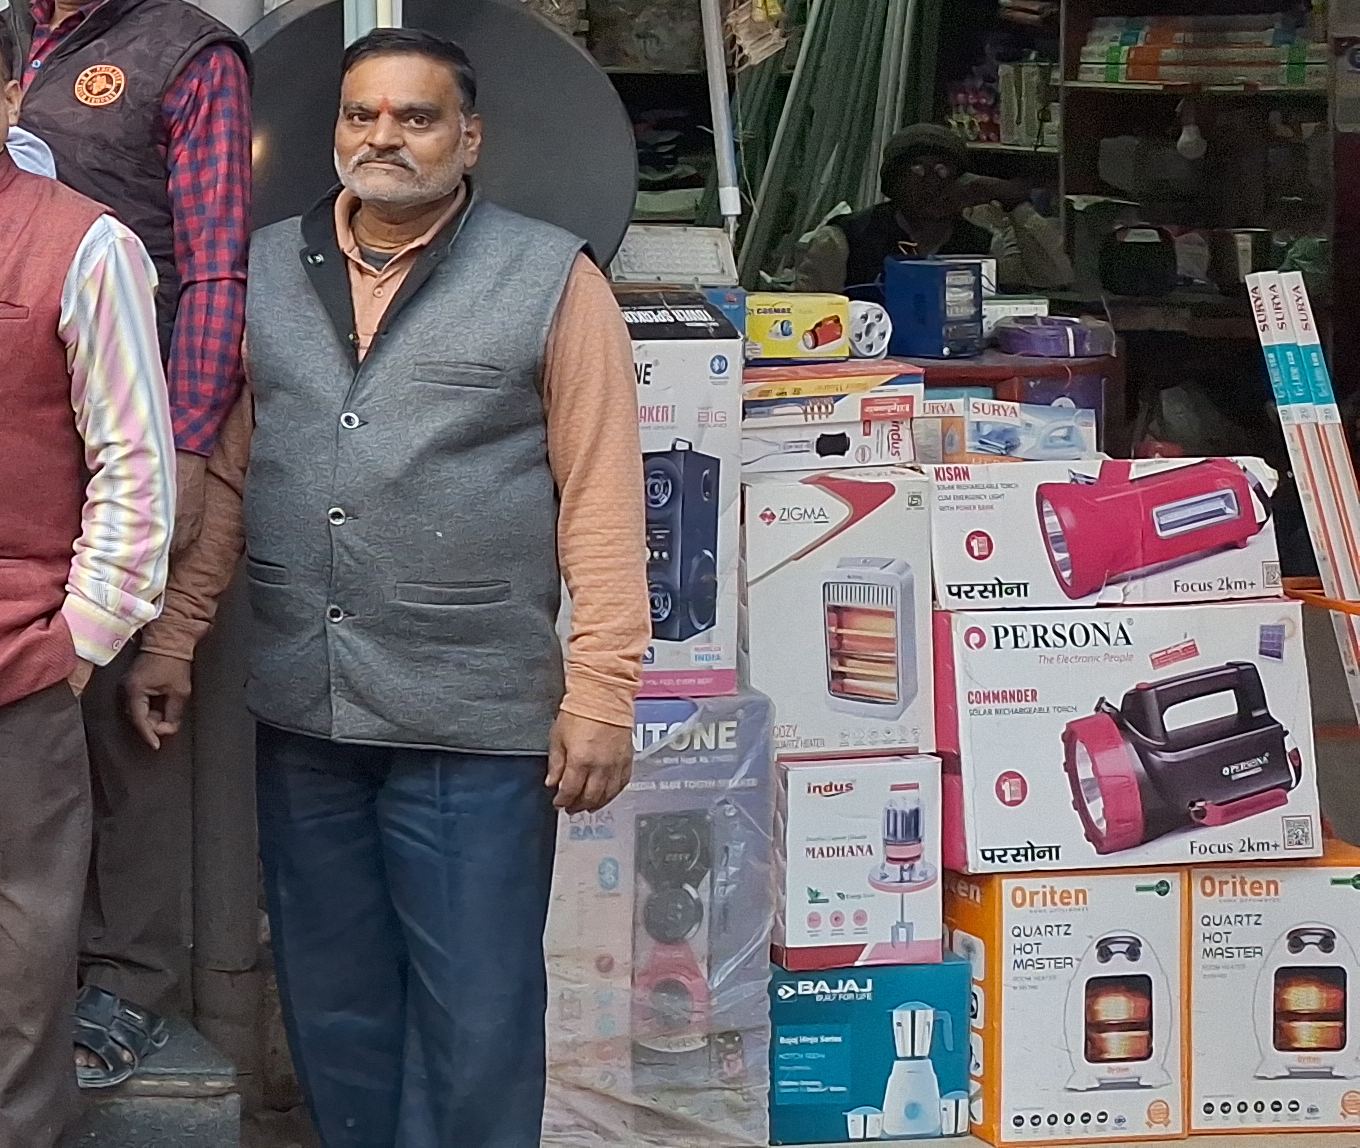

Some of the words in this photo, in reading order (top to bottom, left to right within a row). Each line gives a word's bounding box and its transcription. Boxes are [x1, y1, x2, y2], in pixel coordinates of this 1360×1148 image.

[1249, 284, 1270, 333] SURYA
[1268, 283, 1288, 331] SURYA
[1291, 284, 1312, 332] SURYA
[697, 410, 727, 423] BIG
[971, 402, 1019, 419] SURYA
[934, 466, 971, 481] KISAN
[778, 505, 829, 522] ZIGMA
[945, 577, 1030, 599] परसोना
[1173, 580, 1214, 593] Focus
[1216, 577, 1257, 592] 2km+
[992, 621, 1134, 650] PERSONA
[694, 653, 721, 662] INDIA
[1038, 653, 1055, 664] The
[1056, 652, 1101, 664] Electronic
[1102, 652, 1135, 664] People
[967, 688, 1038, 705] COMMANDER
[806, 781, 855, 796] indus
[805, 844, 874, 859] MADHANA
[980, 841, 1061, 864] परसोना
[1189, 840, 1234, 855] Focus
[1238, 837, 1280, 853] 2km+
[1200, 874, 1281, 898] Oriten
[1010, 884, 1088, 909] Oriten
[1201, 913, 1263, 927] QUARTZ
[1011, 923, 1072, 938] QUARTZ
[1202, 931, 1232, 944] HOT
[1013, 942, 1043, 955] HOT
[1201, 946, 1264, 959] MASTER
[1012, 956, 1074, 971] MASTER
[797, 978, 873, 995] BAJAJ
